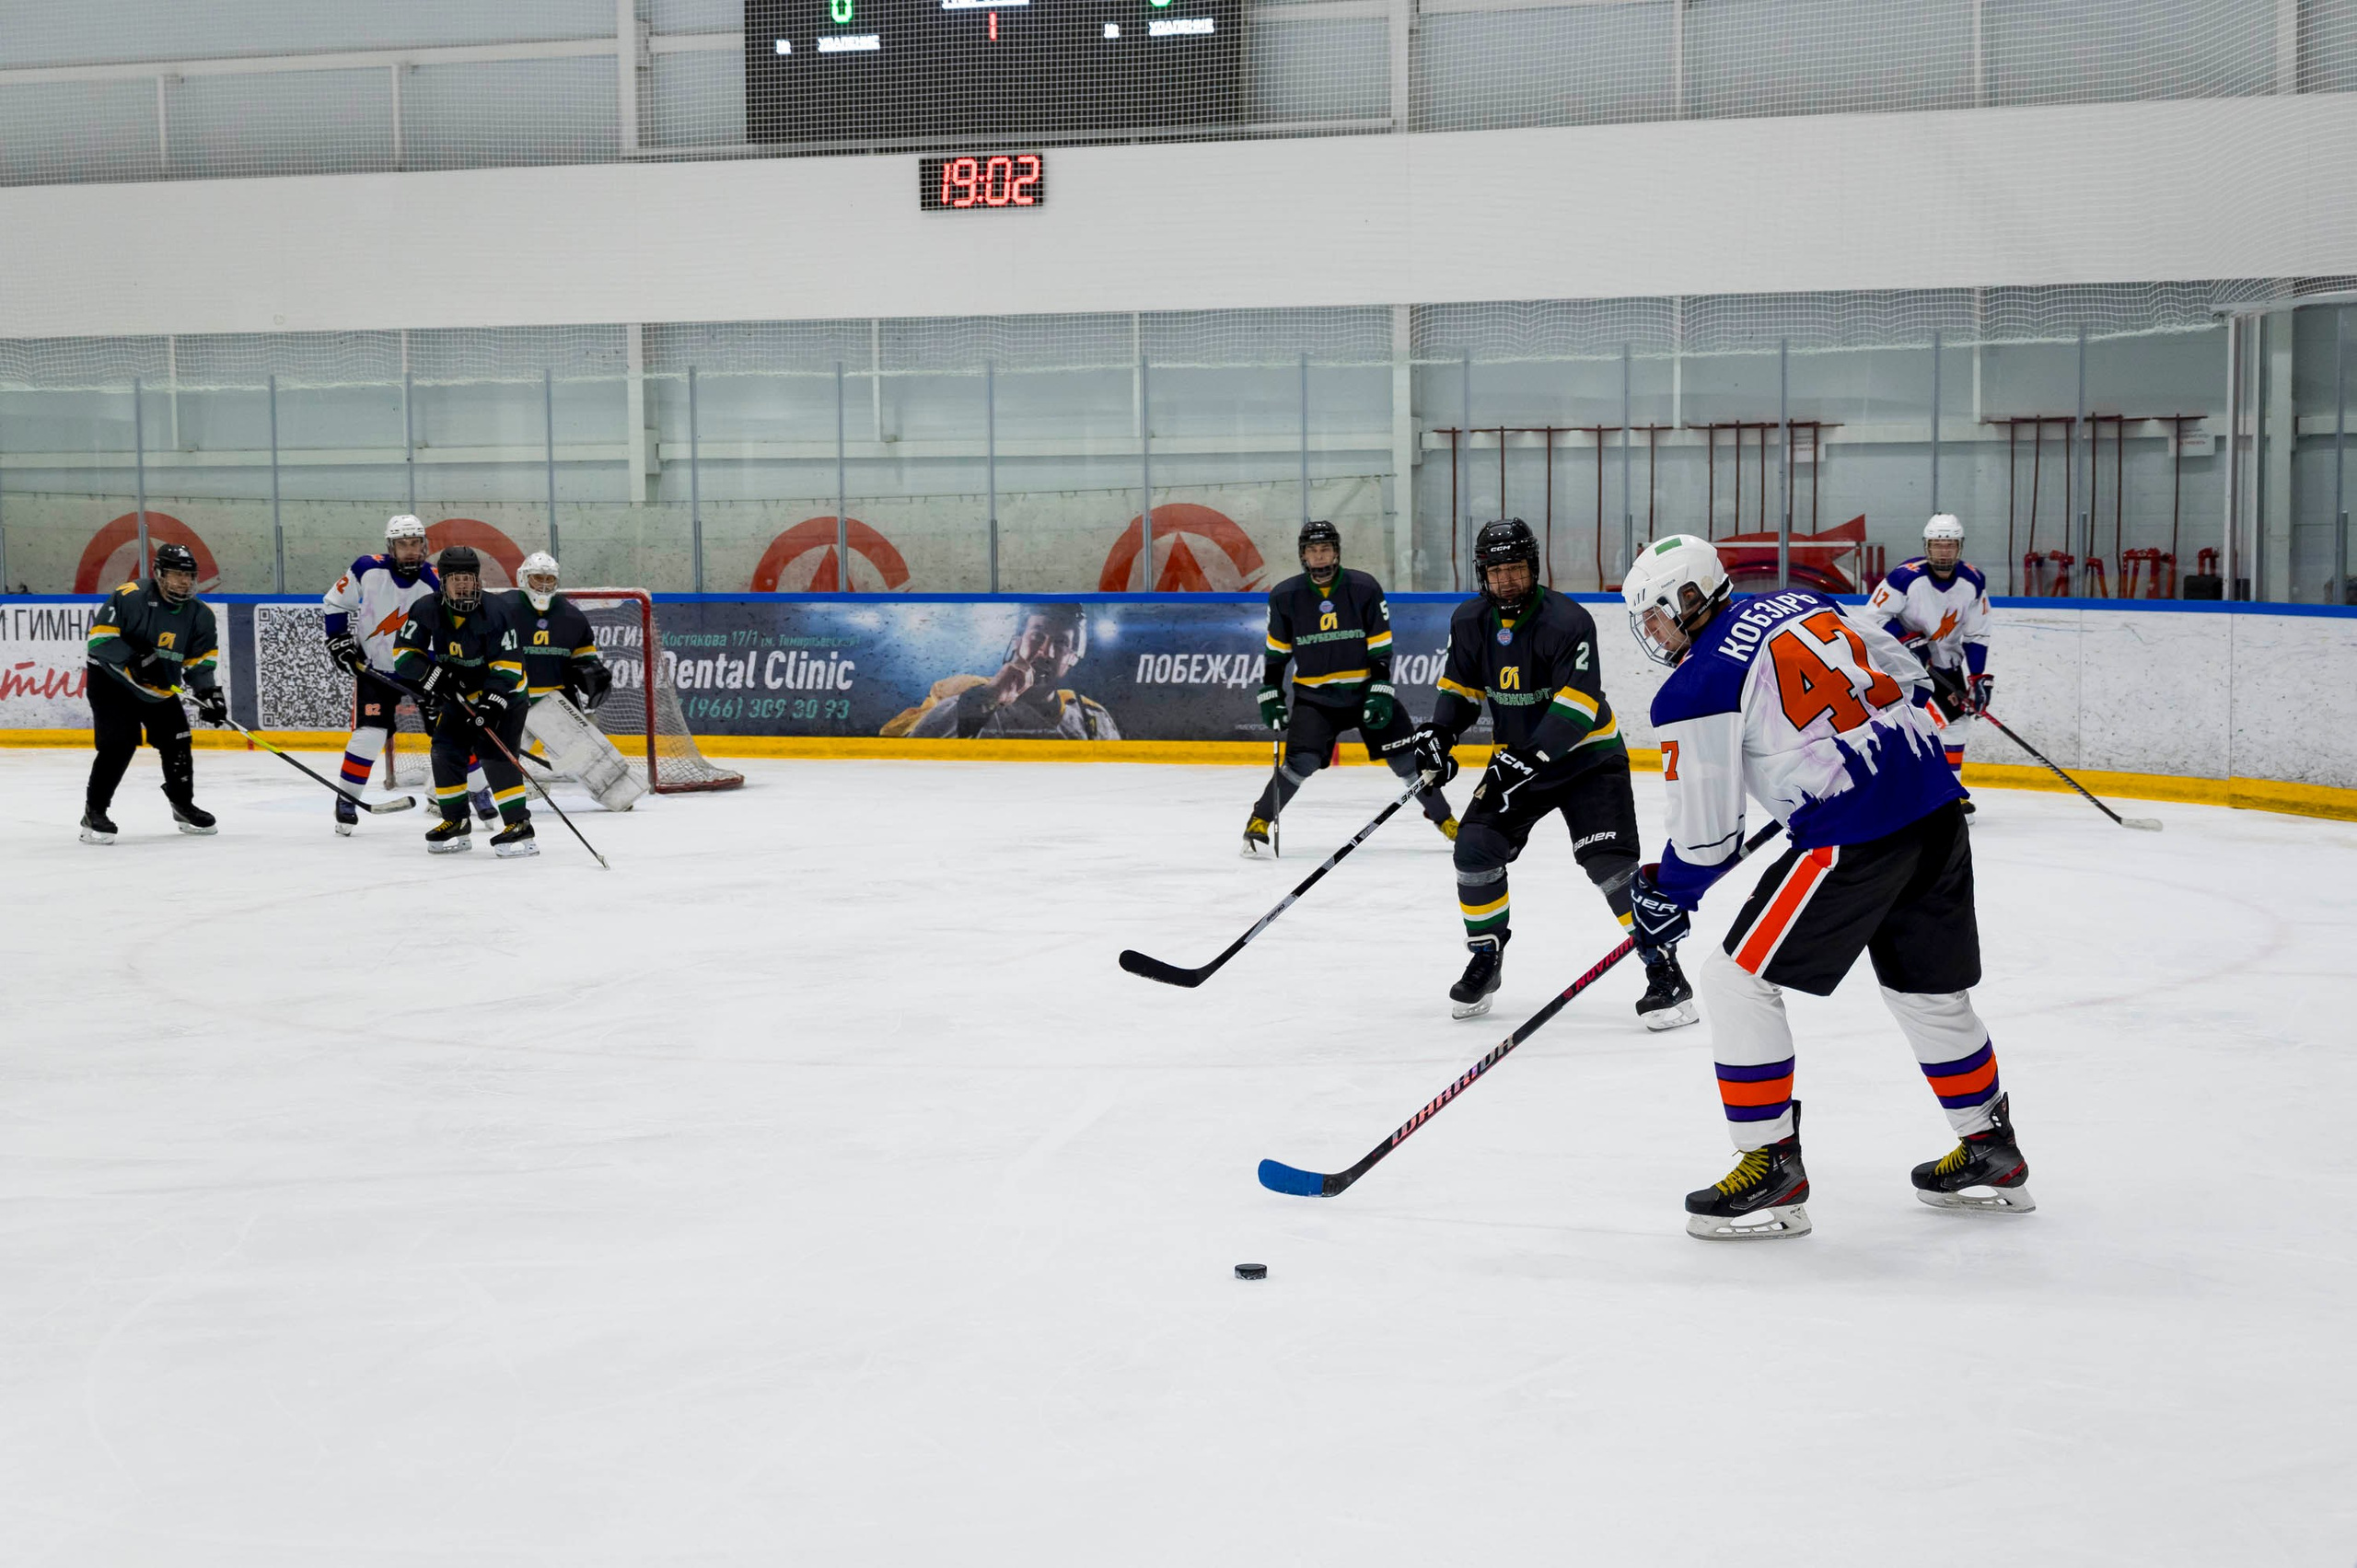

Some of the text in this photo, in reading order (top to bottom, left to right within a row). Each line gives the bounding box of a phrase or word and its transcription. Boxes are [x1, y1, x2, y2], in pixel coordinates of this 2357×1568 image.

[942, 154, 1039, 208] 19:02
[1490, 544, 1511, 552] CCM
[1379, 600, 1389, 621] 5
[1873, 587, 1889, 609] 17
[108, 606, 116, 623] 7
[1718, 592, 1818, 662] КОБЗАРЬ
[501, 628, 517, 651] 47
[730, 629, 758, 647] 17/1
[654, 651, 757, 690] Dental
[764, 650, 855, 690] Clinic
[1136, 654, 1266, 689] ПОБЕЖДА
[1391, 648, 1448, 685] КОЙ
[1575, 642, 1589, 670] 2
[1769, 610, 1903, 734] 47
[688, 696, 744, 719] (966)
[749, 698, 786, 718] 309
[793, 699, 818, 718] 30
[1661, 740, 1680, 782] 7
[1392, 1034, 1515, 1146] WARRIOR
